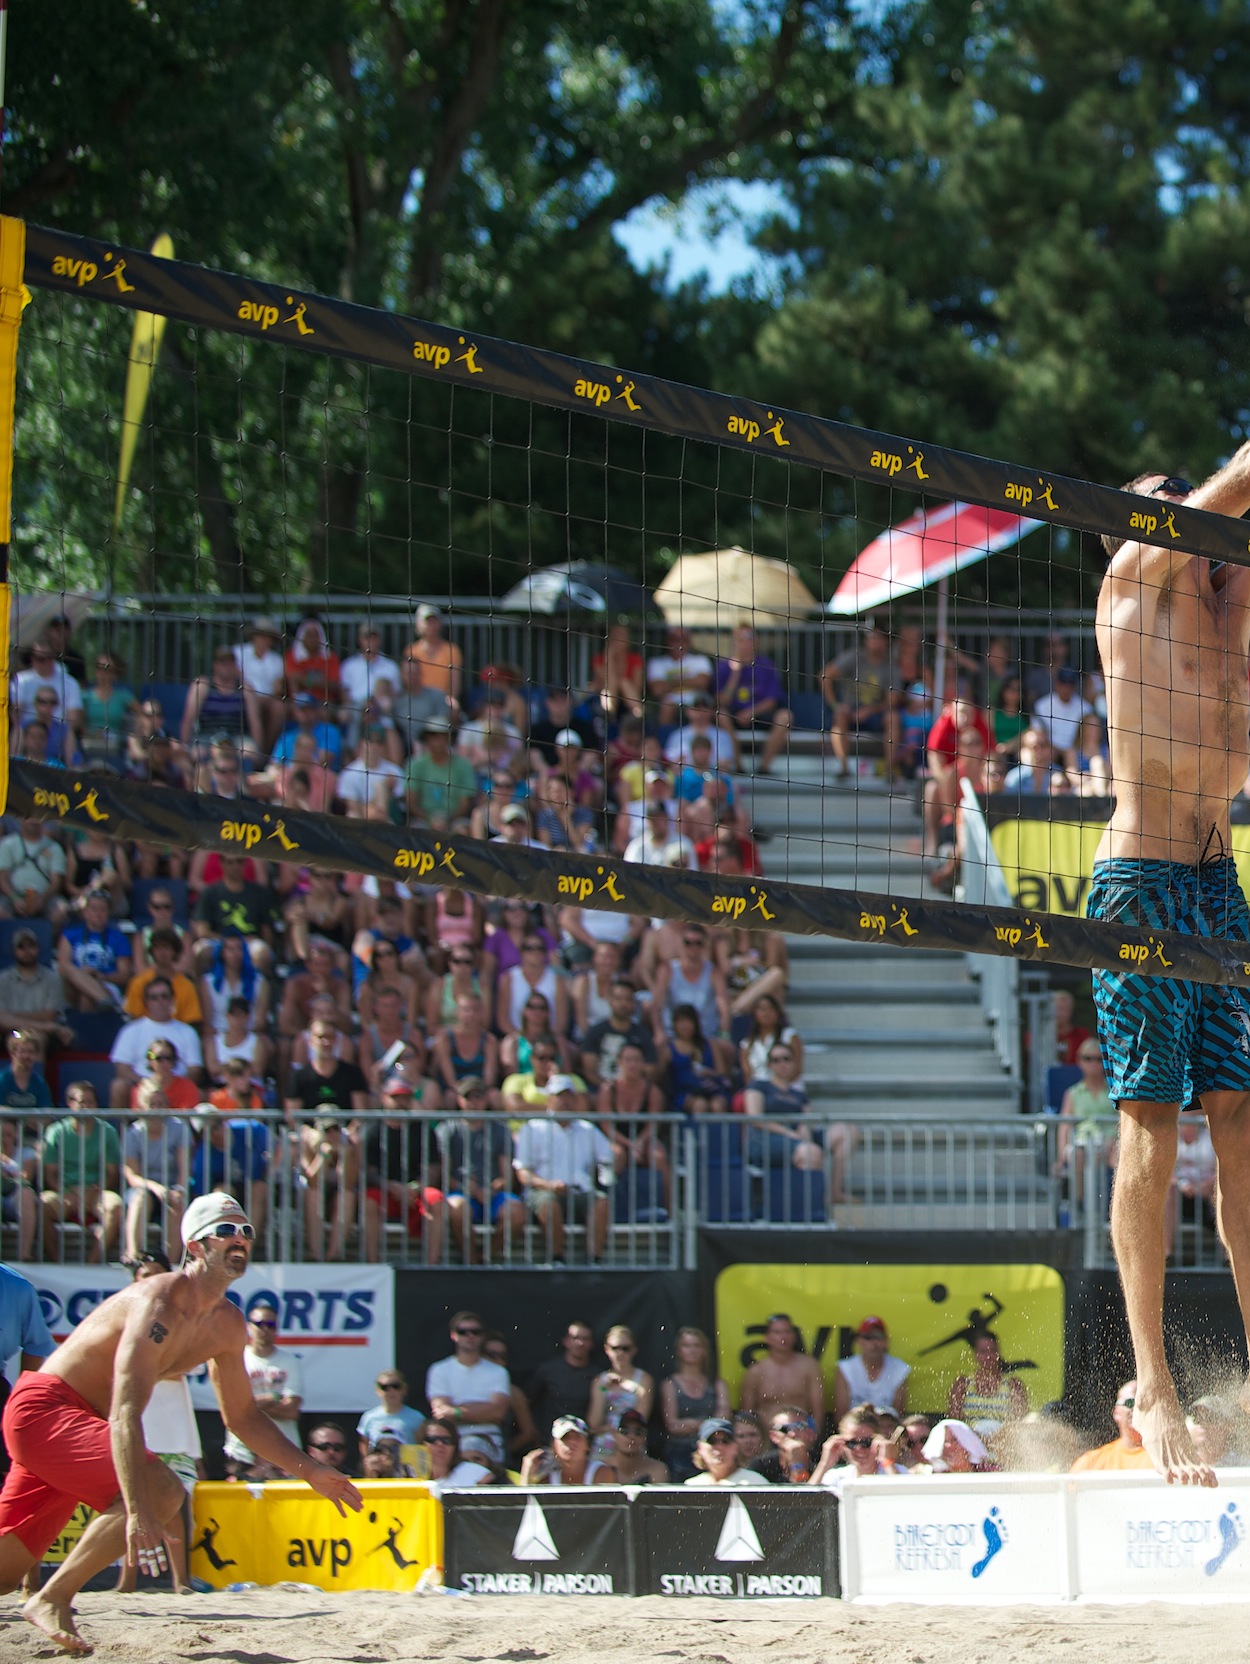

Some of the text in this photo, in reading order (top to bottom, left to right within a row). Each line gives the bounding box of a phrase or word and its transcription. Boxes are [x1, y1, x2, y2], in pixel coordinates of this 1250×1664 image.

[53, 256, 97, 286] avp
[239, 301, 278, 330] avp
[414, 342, 450, 368] avp
[575, 380, 610, 406] avp
[728, 416, 760, 442] avp
[870, 452, 902, 476] avp
[1005, 483, 1032, 506] avp
[1130, 512, 1156, 535] avp
[33, 787, 70, 816] avp
[221, 821, 261, 848] avp
[394, 848, 435, 877] avp
[558, 876, 593, 900] avp
[1014, 874, 1087, 913] av
[712, 897, 746, 919] avp
[860, 912, 886, 935] avp
[1119, 943, 1149, 965] avp
[288, 1536, 351, 1577] avp
[460, 1573, 613, 1594] STAKER PARSON
[660, 1574, 822, 1595] STAKER PARSON
